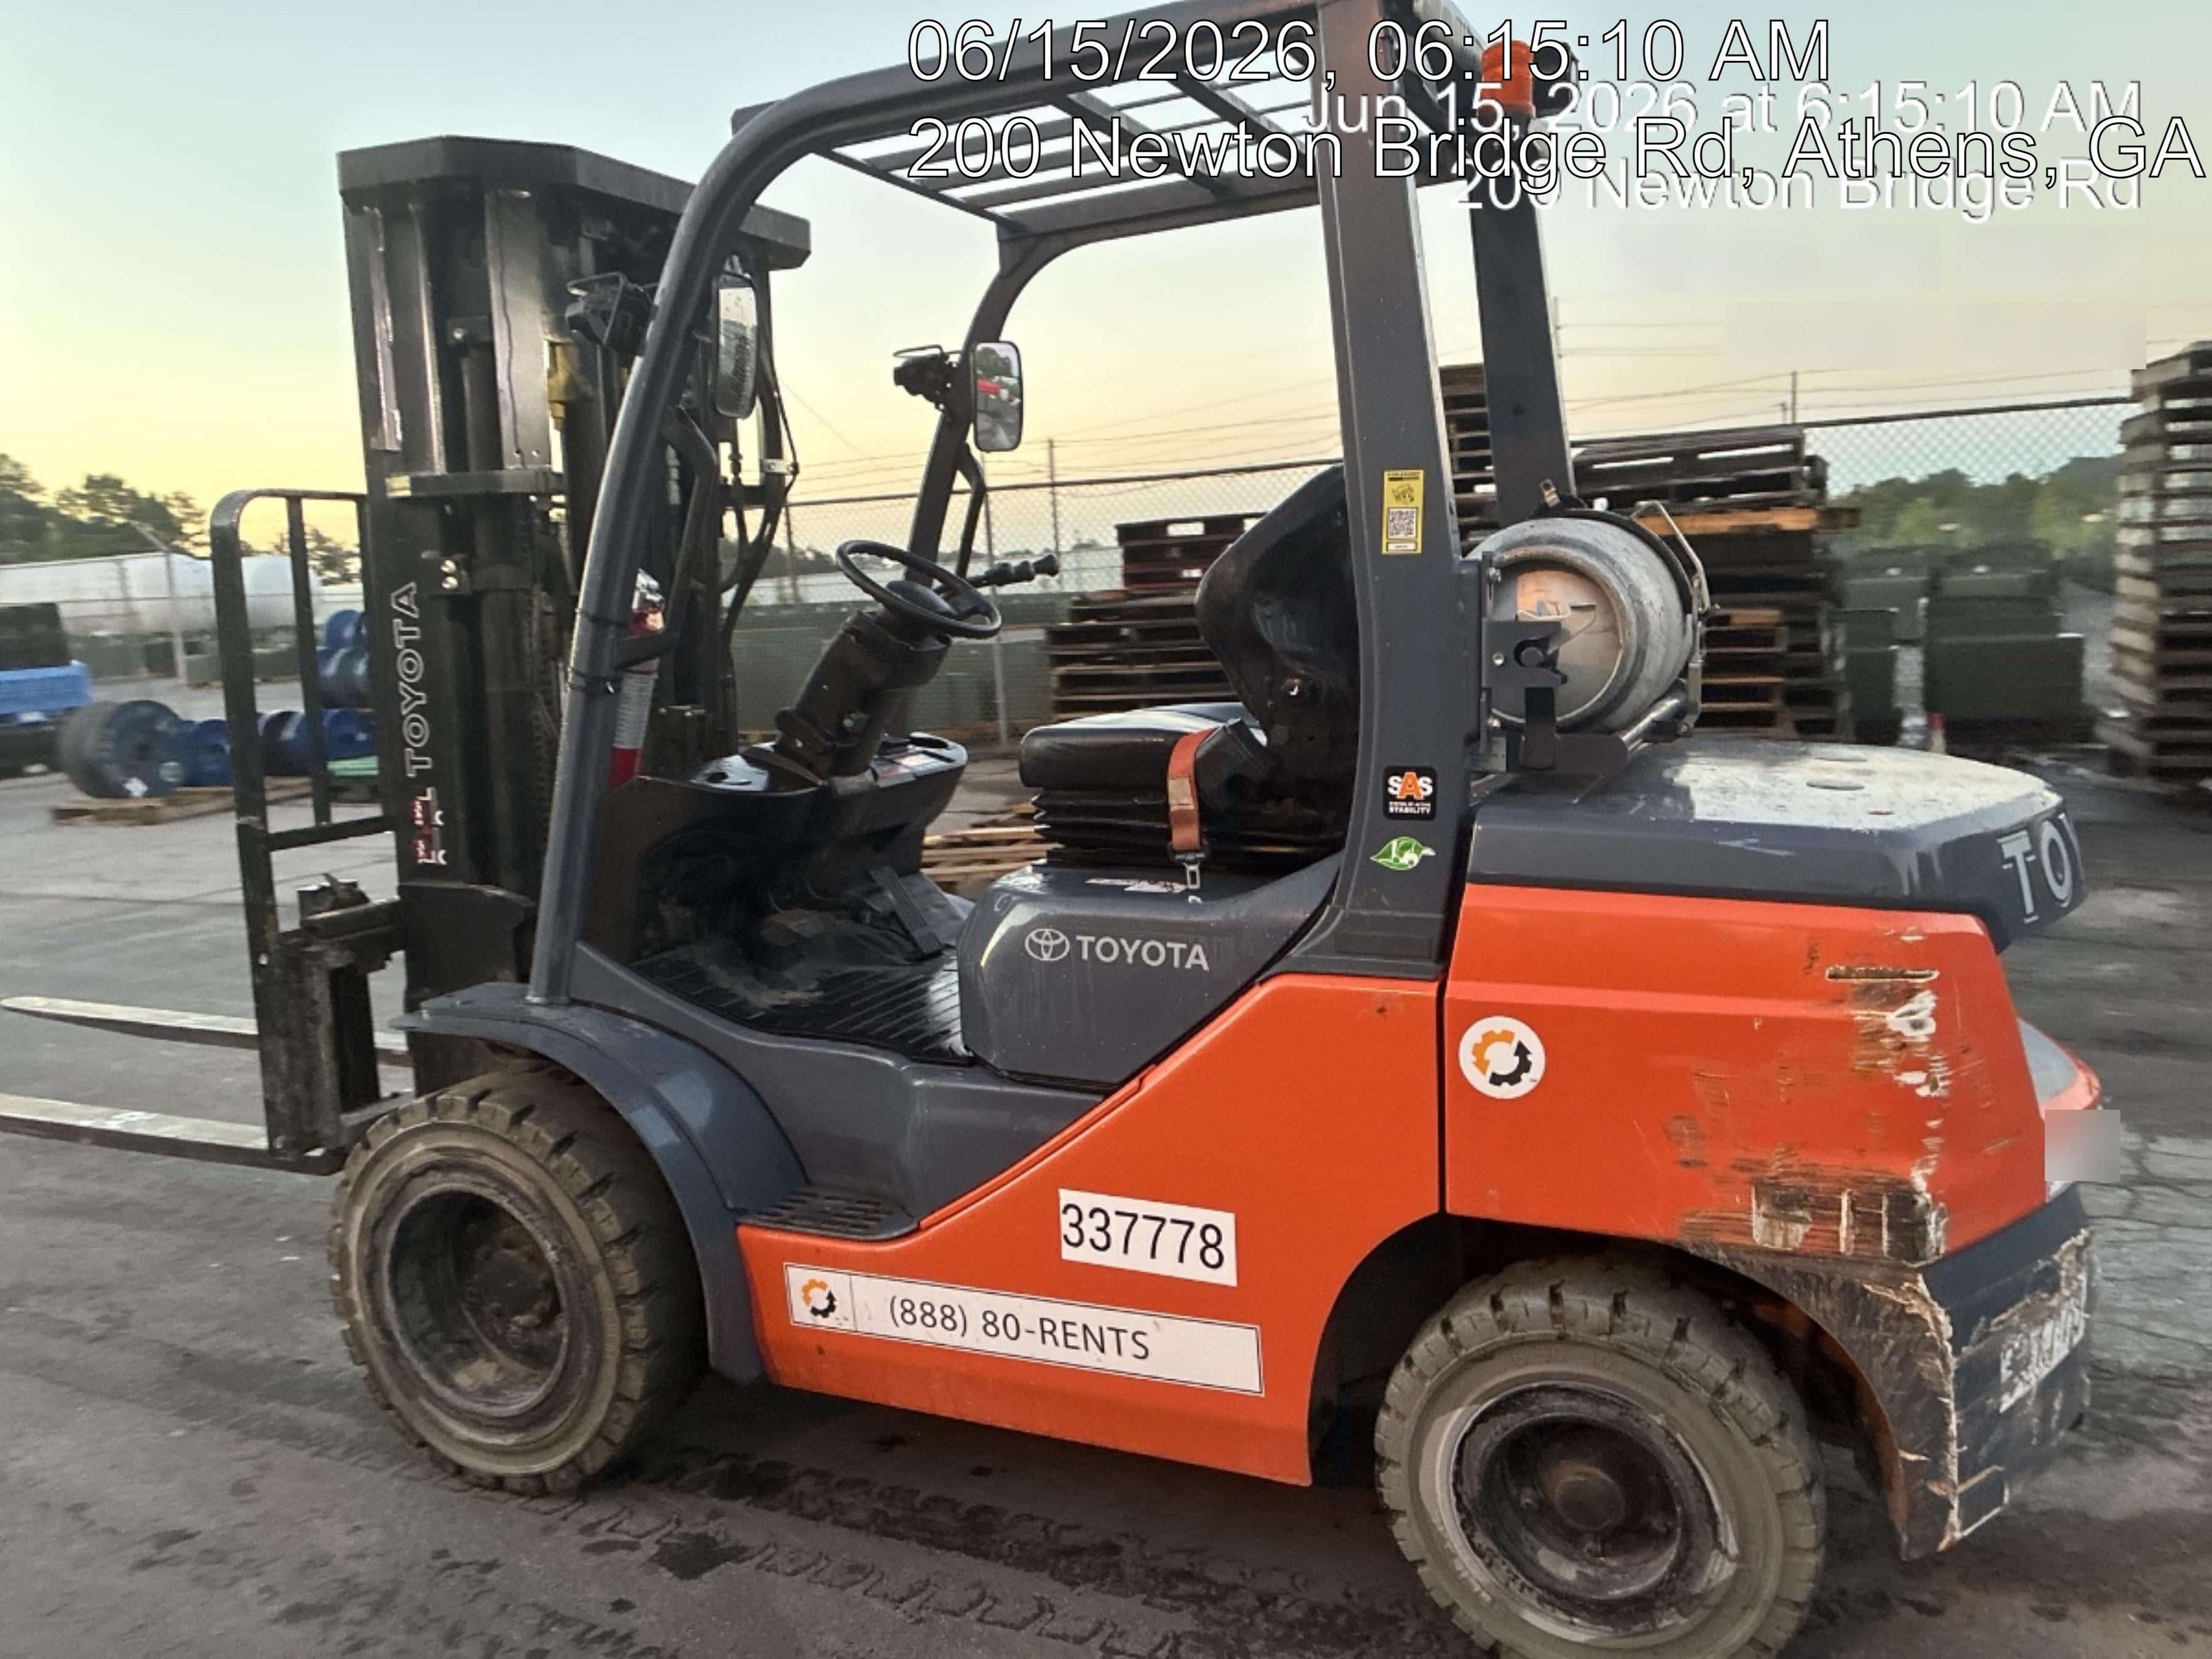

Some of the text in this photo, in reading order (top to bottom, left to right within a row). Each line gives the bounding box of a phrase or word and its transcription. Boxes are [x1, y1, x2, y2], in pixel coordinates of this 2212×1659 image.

[391, 581, 433, 778] TOYOTA
[1387, 771, 1433, 800] SAS
[1076, 934, 1210, 972] TOYOTA
[1061, 1202, 1225, 1270] 337778
[888, 1294, 1150, 1360] (888) 80-RENTS
